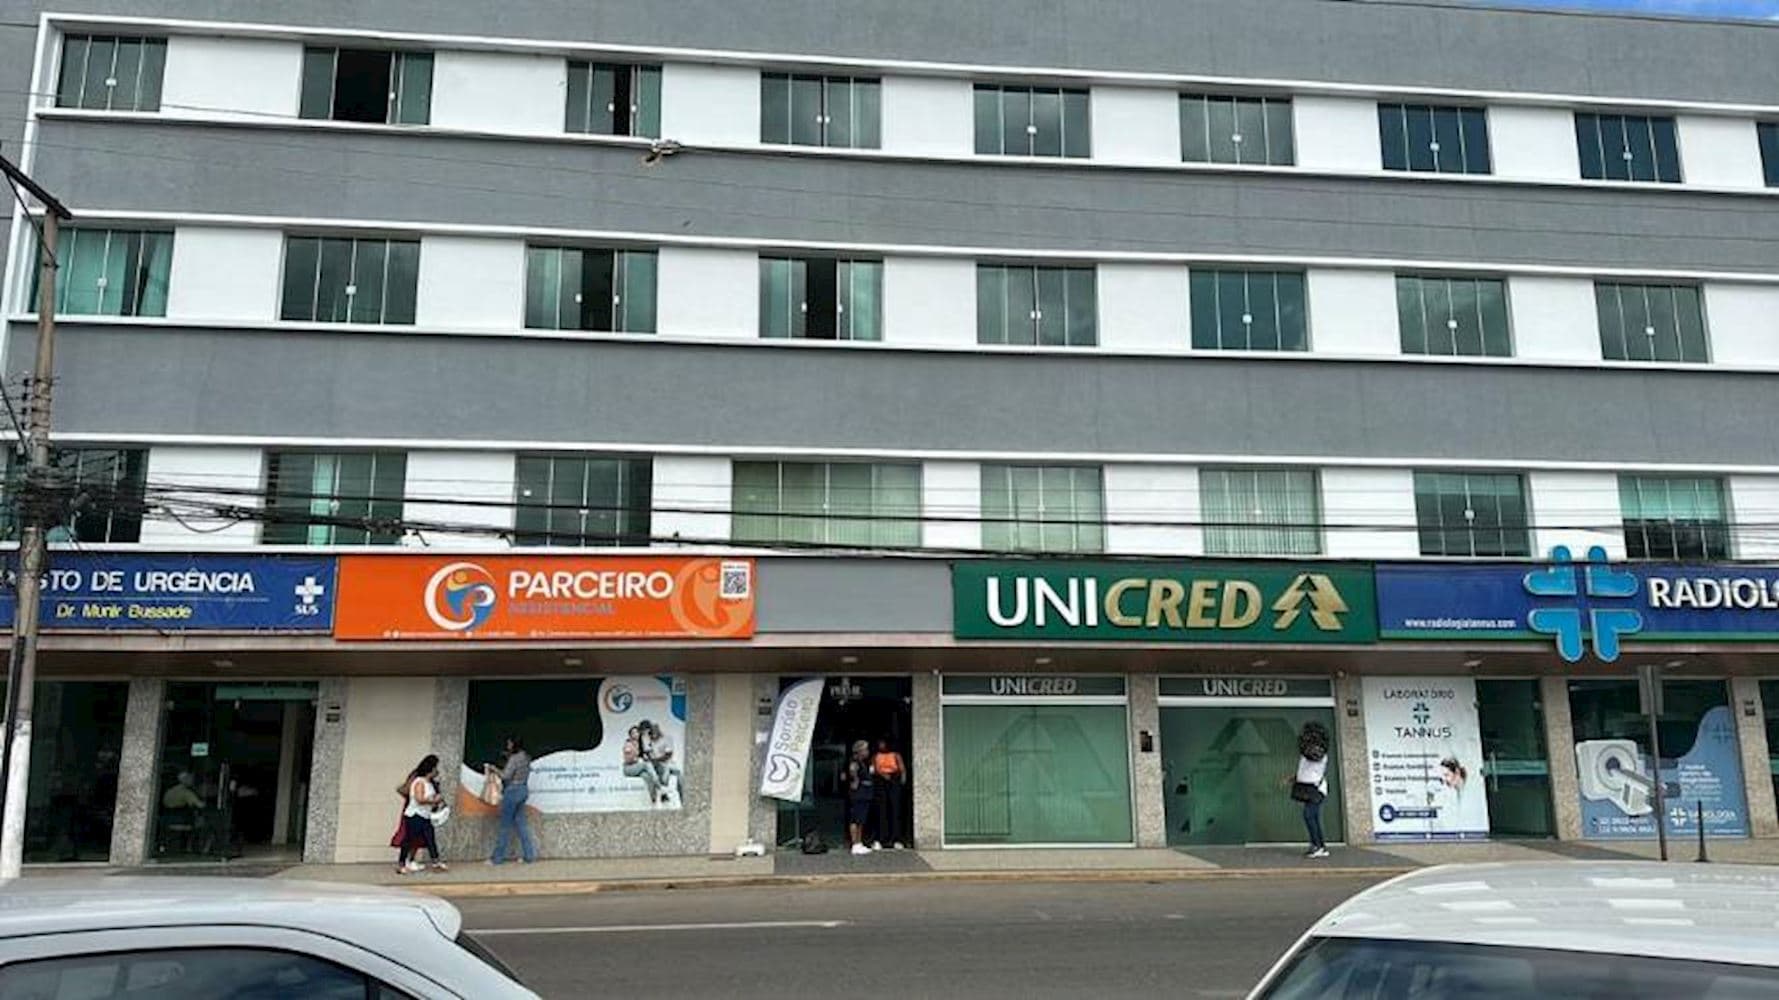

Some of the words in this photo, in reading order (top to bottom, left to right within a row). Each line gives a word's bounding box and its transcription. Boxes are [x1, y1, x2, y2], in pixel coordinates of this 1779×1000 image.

[91, 571, 125, 592] DE
[134, 567, 255, 592] URGÊNCIA
[508, 570, 674, 599] PARCEIRO
[294, 604, 319, 616] SUS
[986, 576, 1262, 629] UNICRED
[991, 678, 1077, 696] UNICRED
[1203, 678, 1288, 697] UNICRED
[1394, 726, 1452, 739] TANNUS
